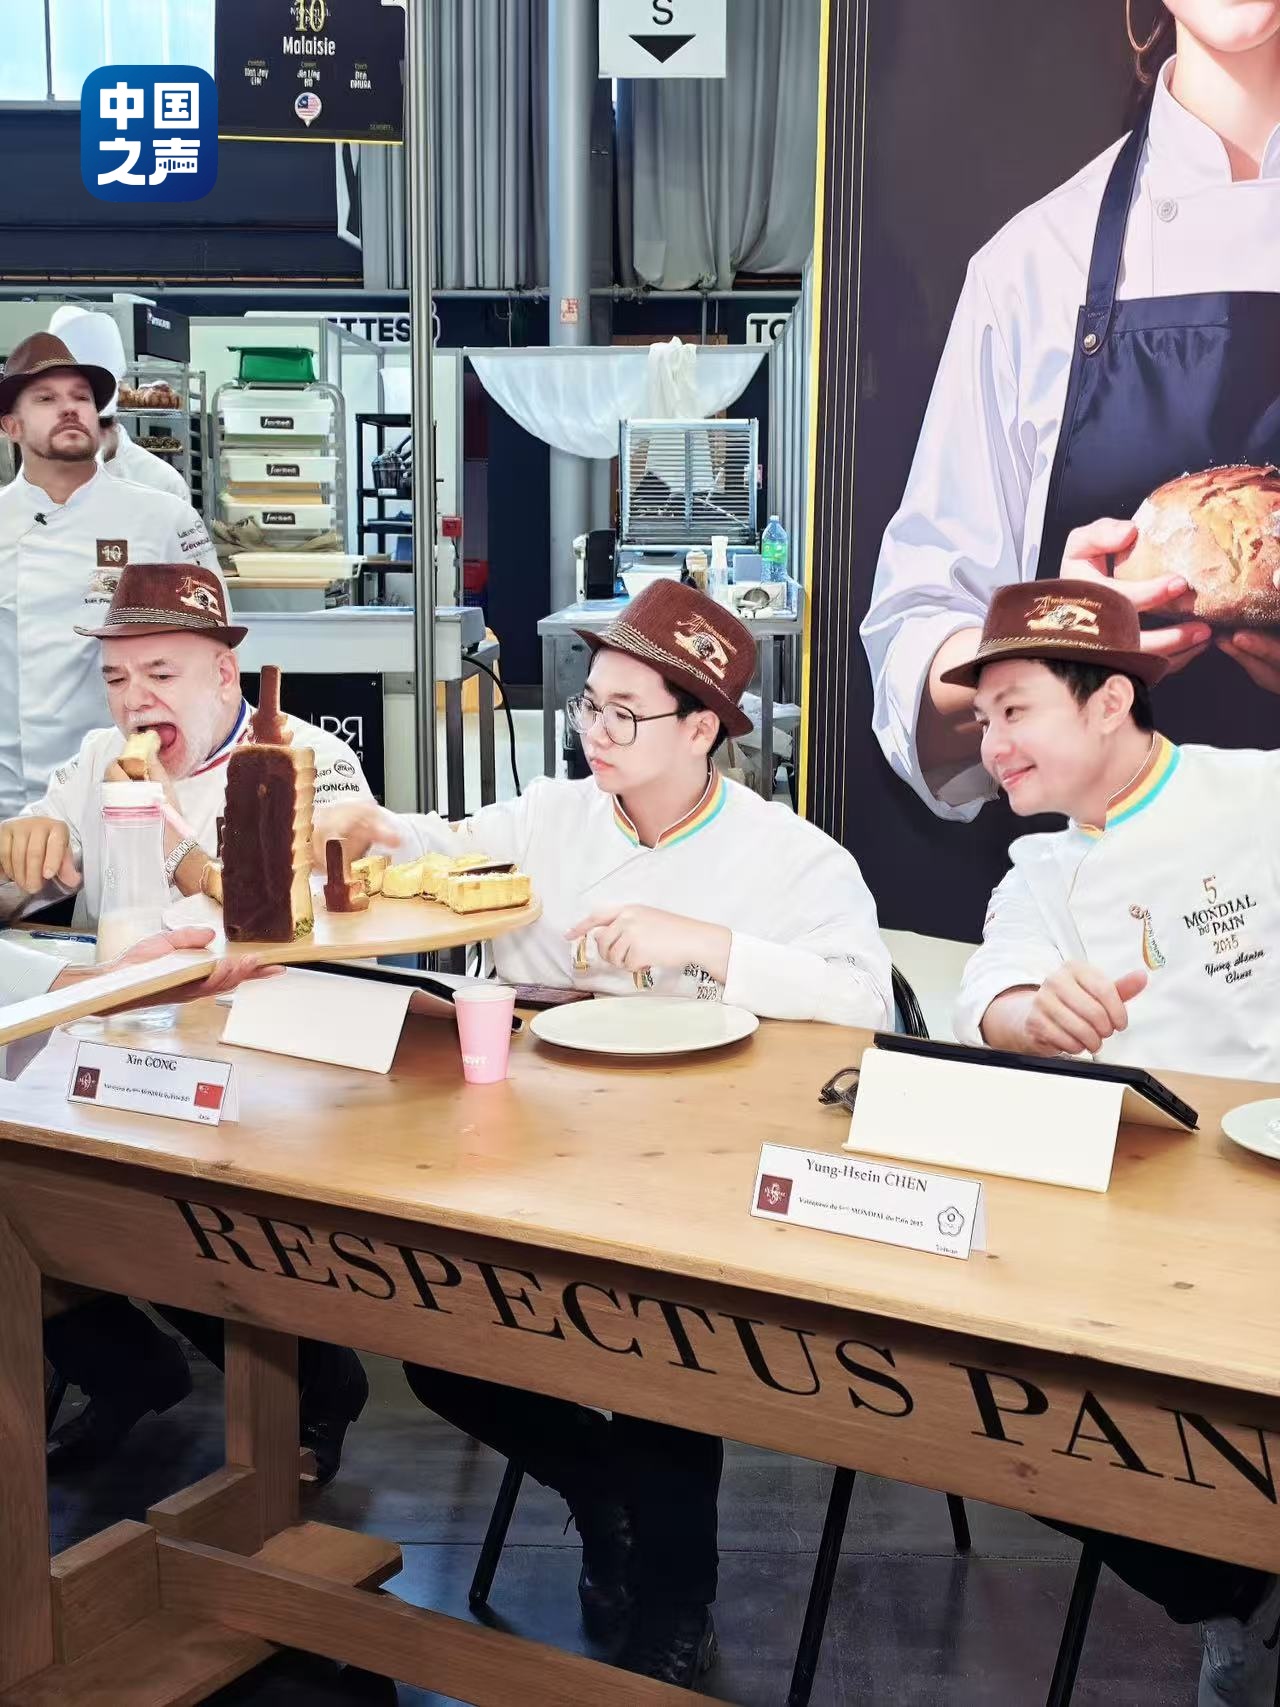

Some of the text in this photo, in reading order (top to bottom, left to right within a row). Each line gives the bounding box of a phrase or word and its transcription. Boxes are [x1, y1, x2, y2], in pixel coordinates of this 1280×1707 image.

[283, 36, 336, 56] Malaisie
[1183, 894, 1257, 929] MONDIAL
[1212, 914, 1245, 935] PAIN
[1213, 935, 1239, 954] 2015
[126, 1053, 143, 1066] Xin
[884, 1171, 928, 1193] CHEN
[165, 1195, 1280, 1505] RESPECTUS PAN
